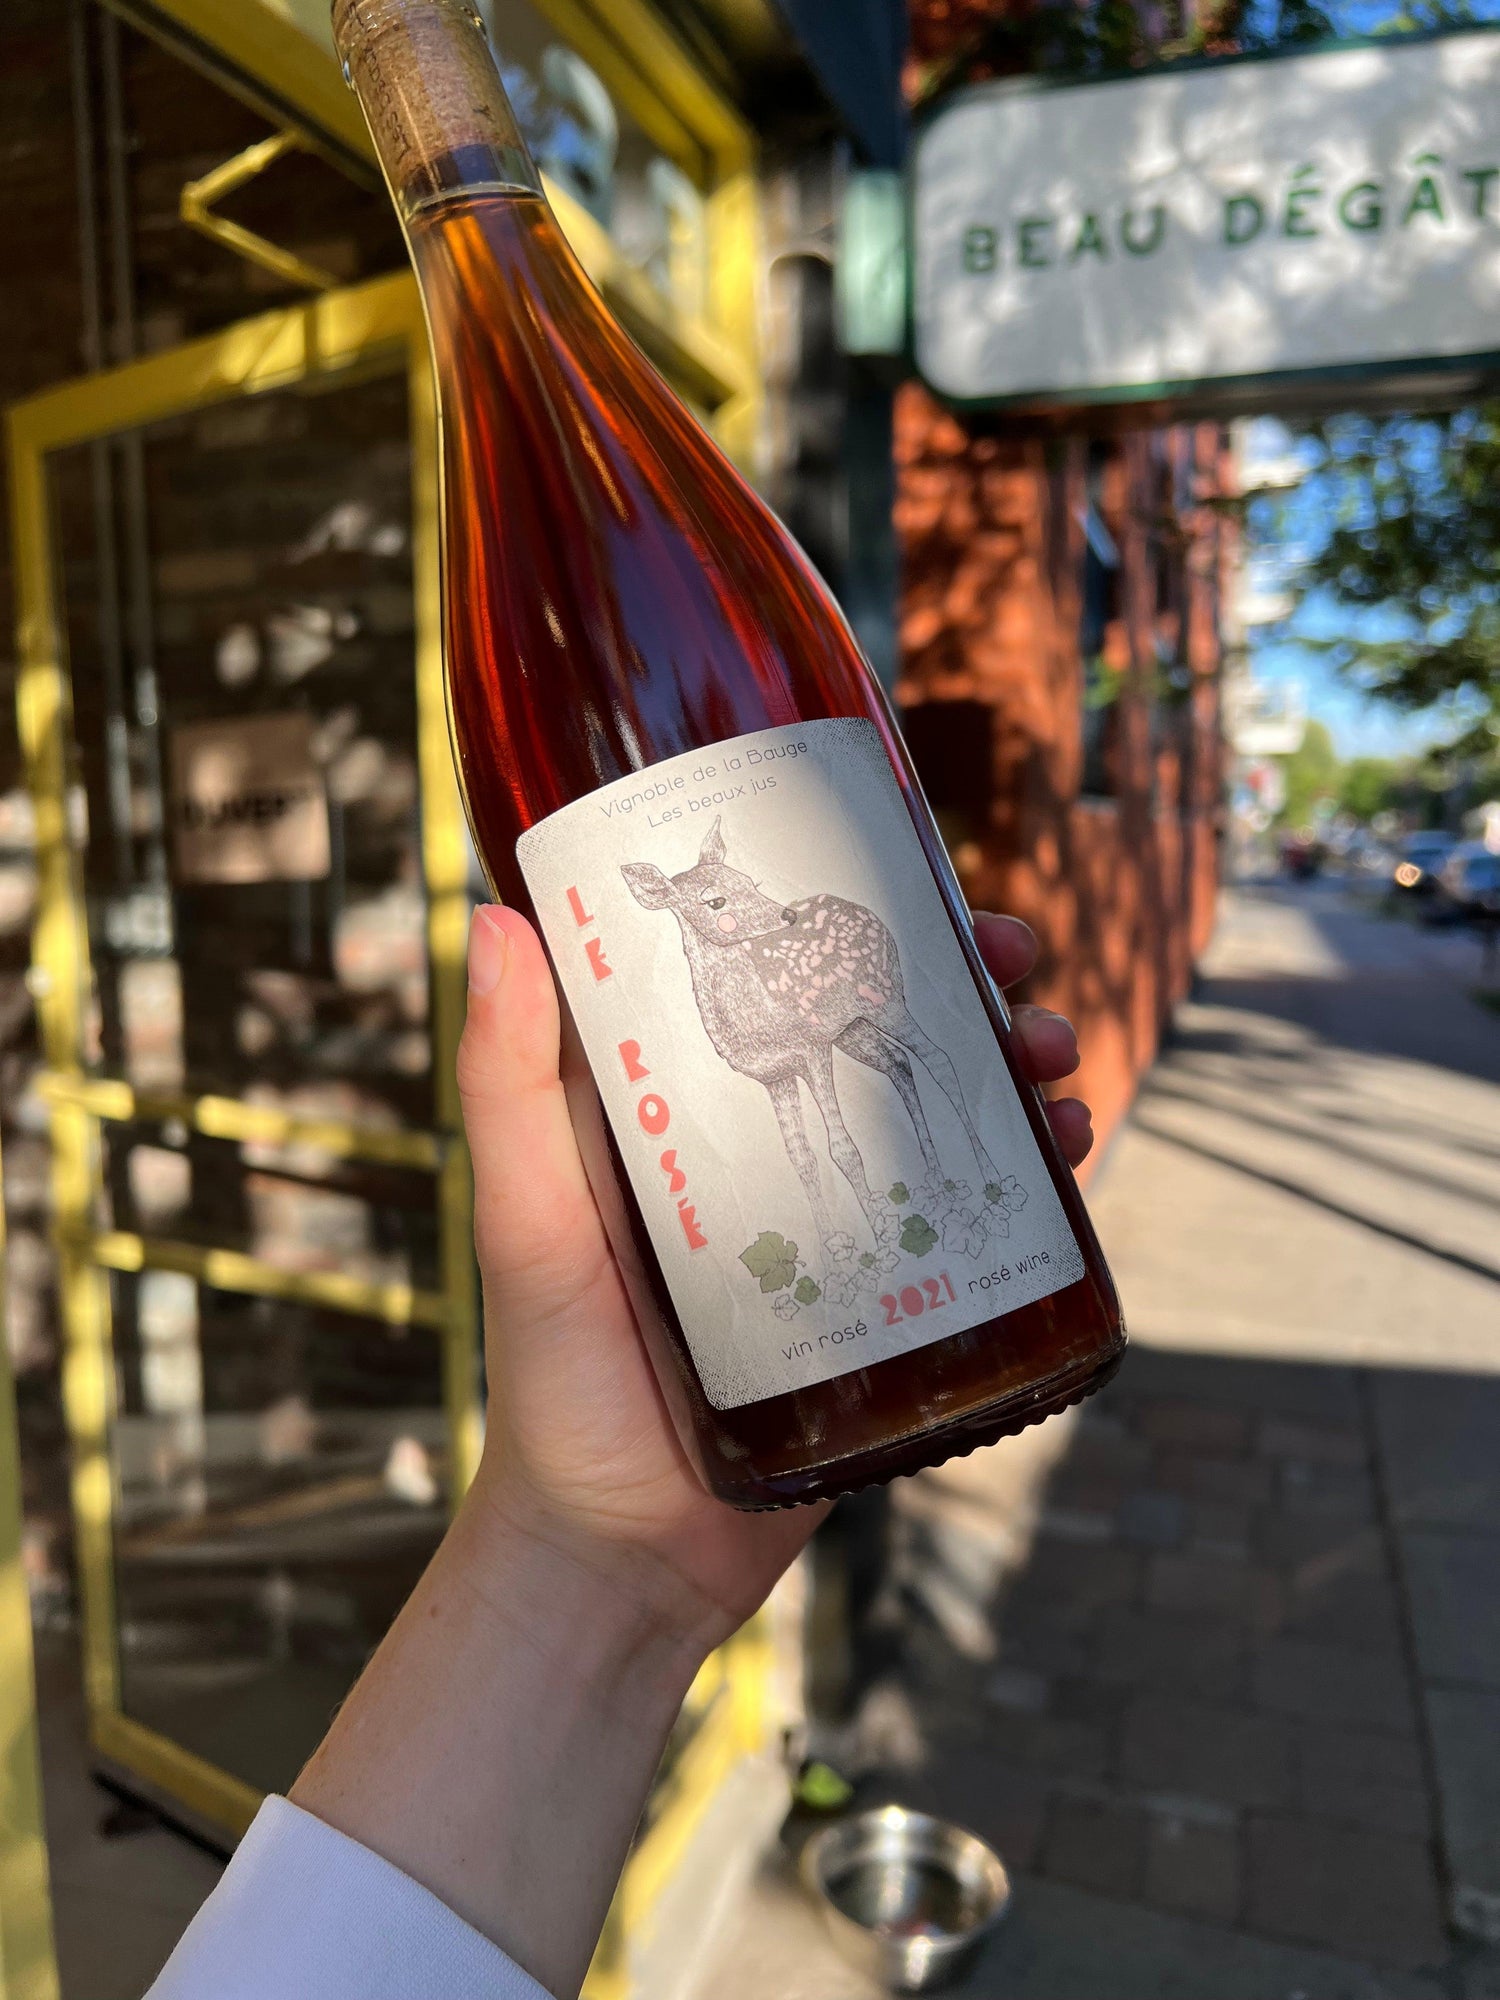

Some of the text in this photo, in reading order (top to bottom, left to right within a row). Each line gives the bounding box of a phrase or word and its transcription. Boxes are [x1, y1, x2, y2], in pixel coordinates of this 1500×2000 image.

[961, 153, 1500, 274] BEAU DÉGÂT
[600, 741, 808, 818] Vignoble de la Bauge
[647, 775, 777, 828] Les beaux jus
[566, 885, 708, 1250] LE ROSÉ
[781, 1250, 1050, 1360] vin rosé 2021 rosé wine
